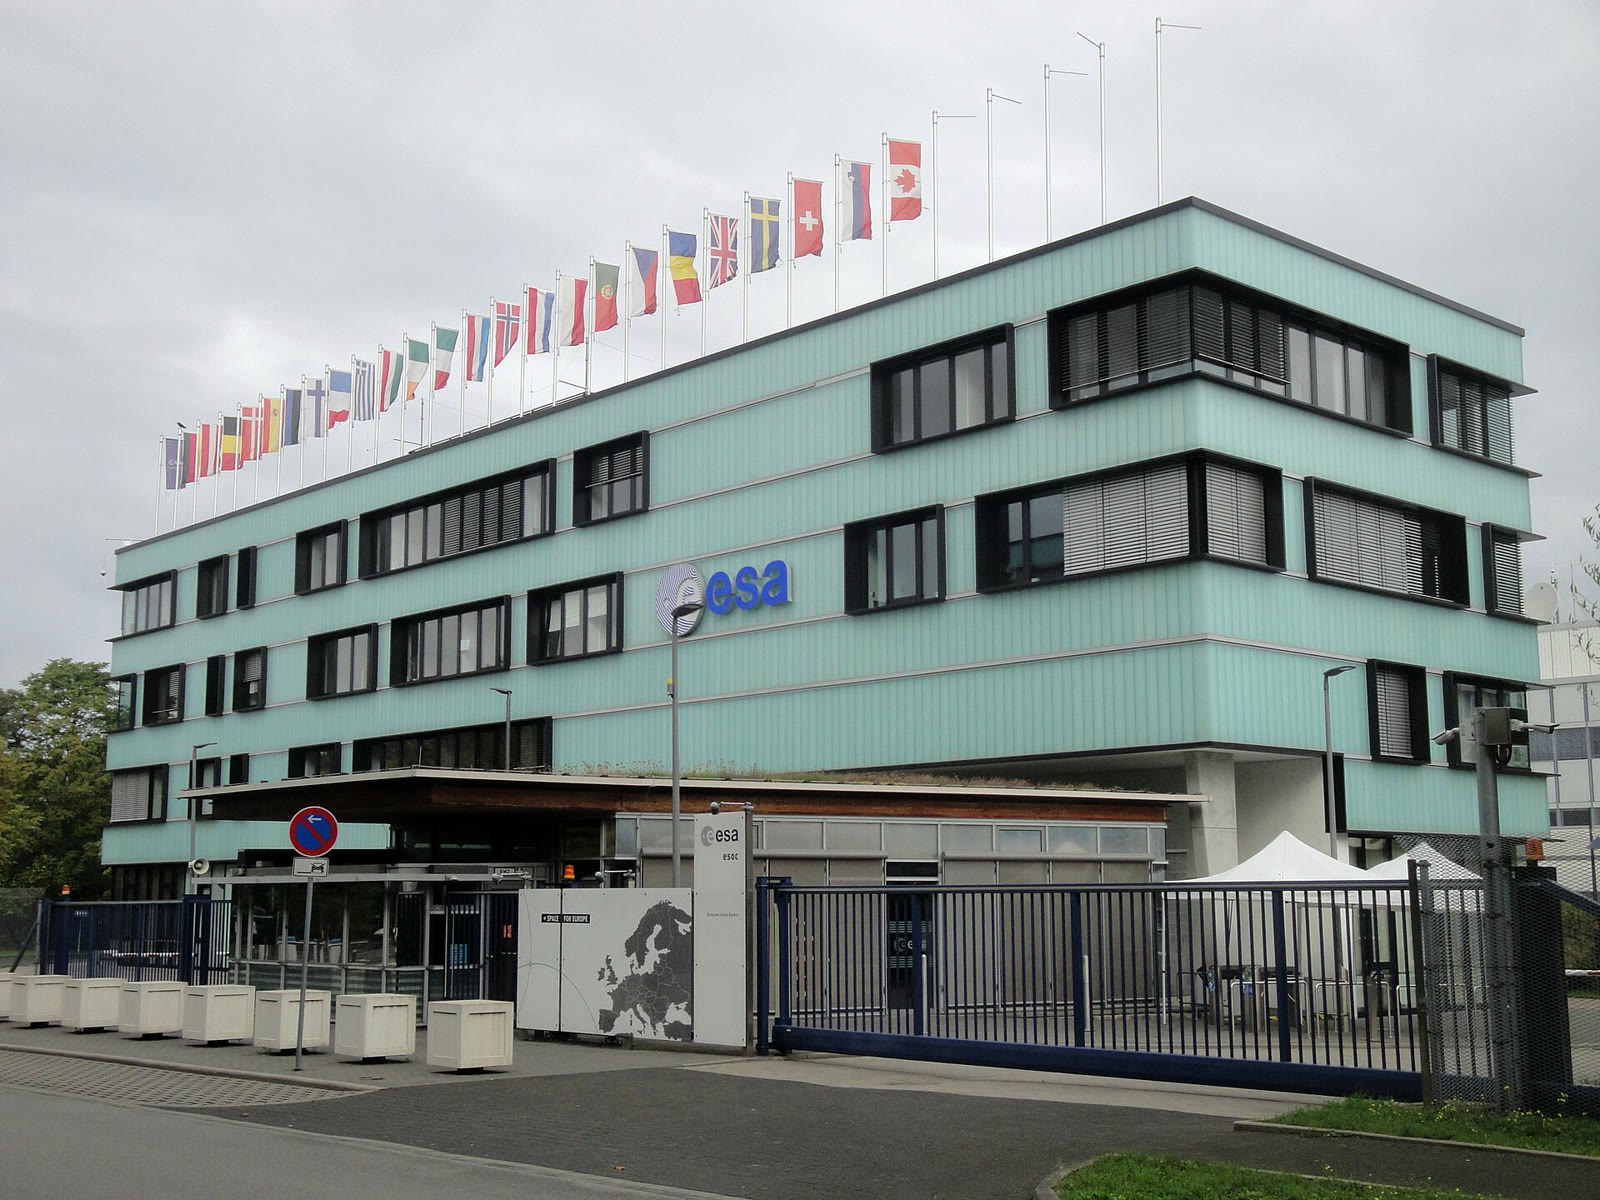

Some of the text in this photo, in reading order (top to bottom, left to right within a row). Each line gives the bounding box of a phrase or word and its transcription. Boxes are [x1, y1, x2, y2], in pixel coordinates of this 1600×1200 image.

[706, 560, 790, 614] esa
[716, 829, 738, 842] esa
[907, 940, 926, 949] ea
